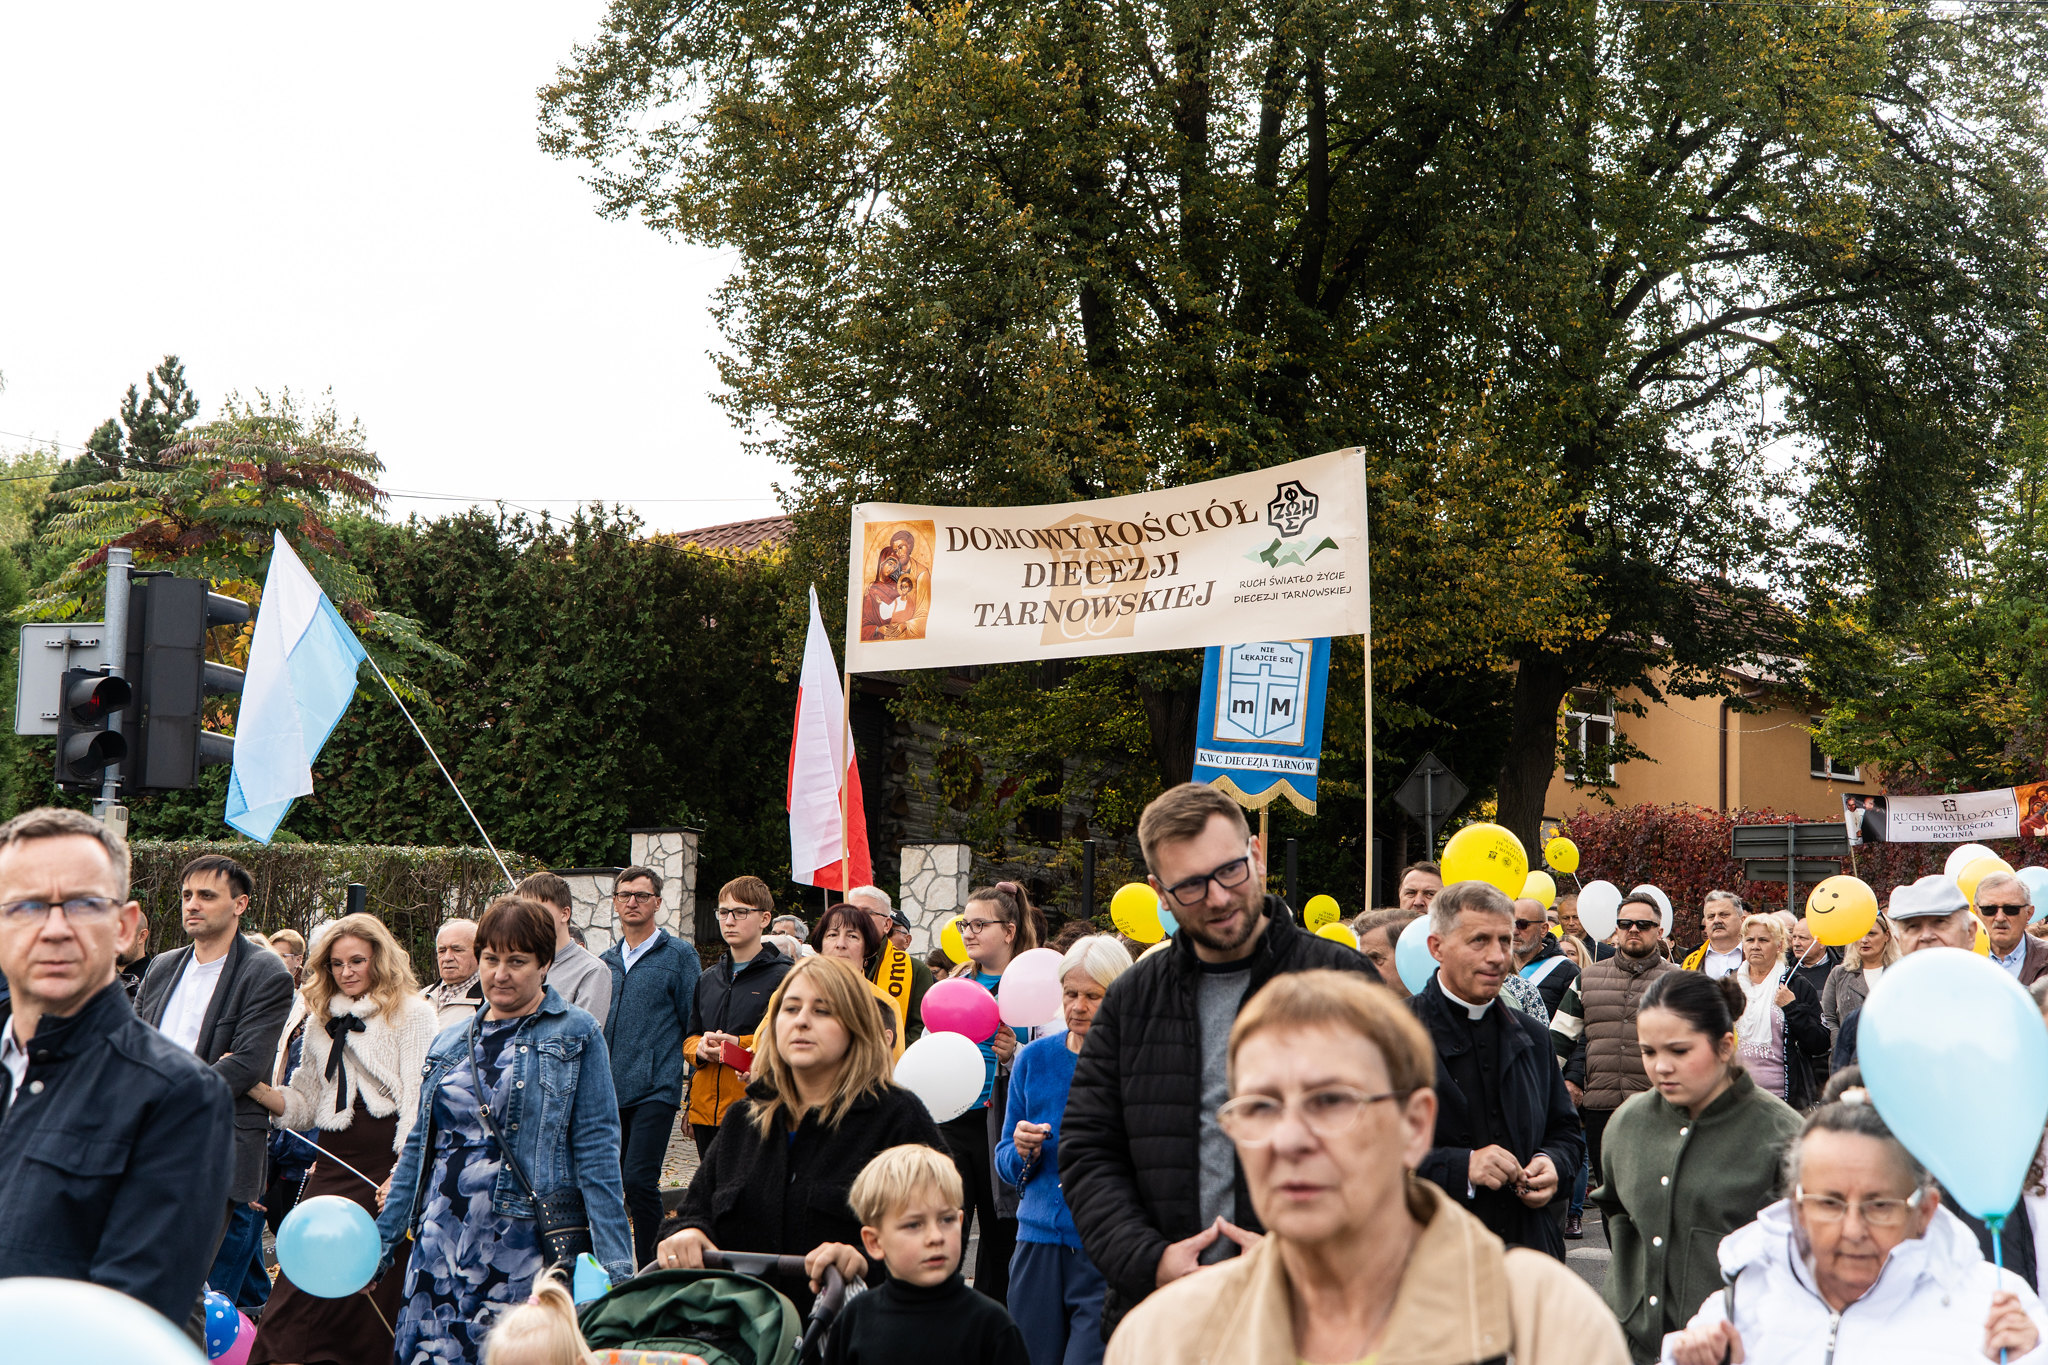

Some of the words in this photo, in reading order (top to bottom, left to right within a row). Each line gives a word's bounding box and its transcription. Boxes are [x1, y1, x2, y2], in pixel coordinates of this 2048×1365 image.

[946, 526, 1085, 552] DOMOWY
[1090, 499, 1258, 548] KOŚCIÓŁ
[1021, 551, 1180, 588] DIECEZJI
[1239, 578, 1266, 588] RUCH
[1269, 574, 1313, 586] ŚWIATŁO
[1317, 571, 1345, 581] ŻYCIE
[1234, 593, 1278, 603] DIECEZJI
[1282, 586, 1352, 600] TARNOWSKIEJ
[973, 580, 1216, 627] TARNOWSKIEJ
[1280, 656, 1293, 664] SIĘ
[1232, 699, 1254, 714] m
[1270, 697, 1291, 716] M
[1200, 752, 1223, 764] KWC
[1224, 755, 1269, 768] DIECEZJA
[1271, 758, 1315, 771] TARNÓW
[1893, 812, 1925, 821] RUCH
[1957, 821, 1994, 831] KOŚCIÓŁ
[1933, 831, 1973, 839] BOCHNIA
[888, 949, 906, 998] omo
